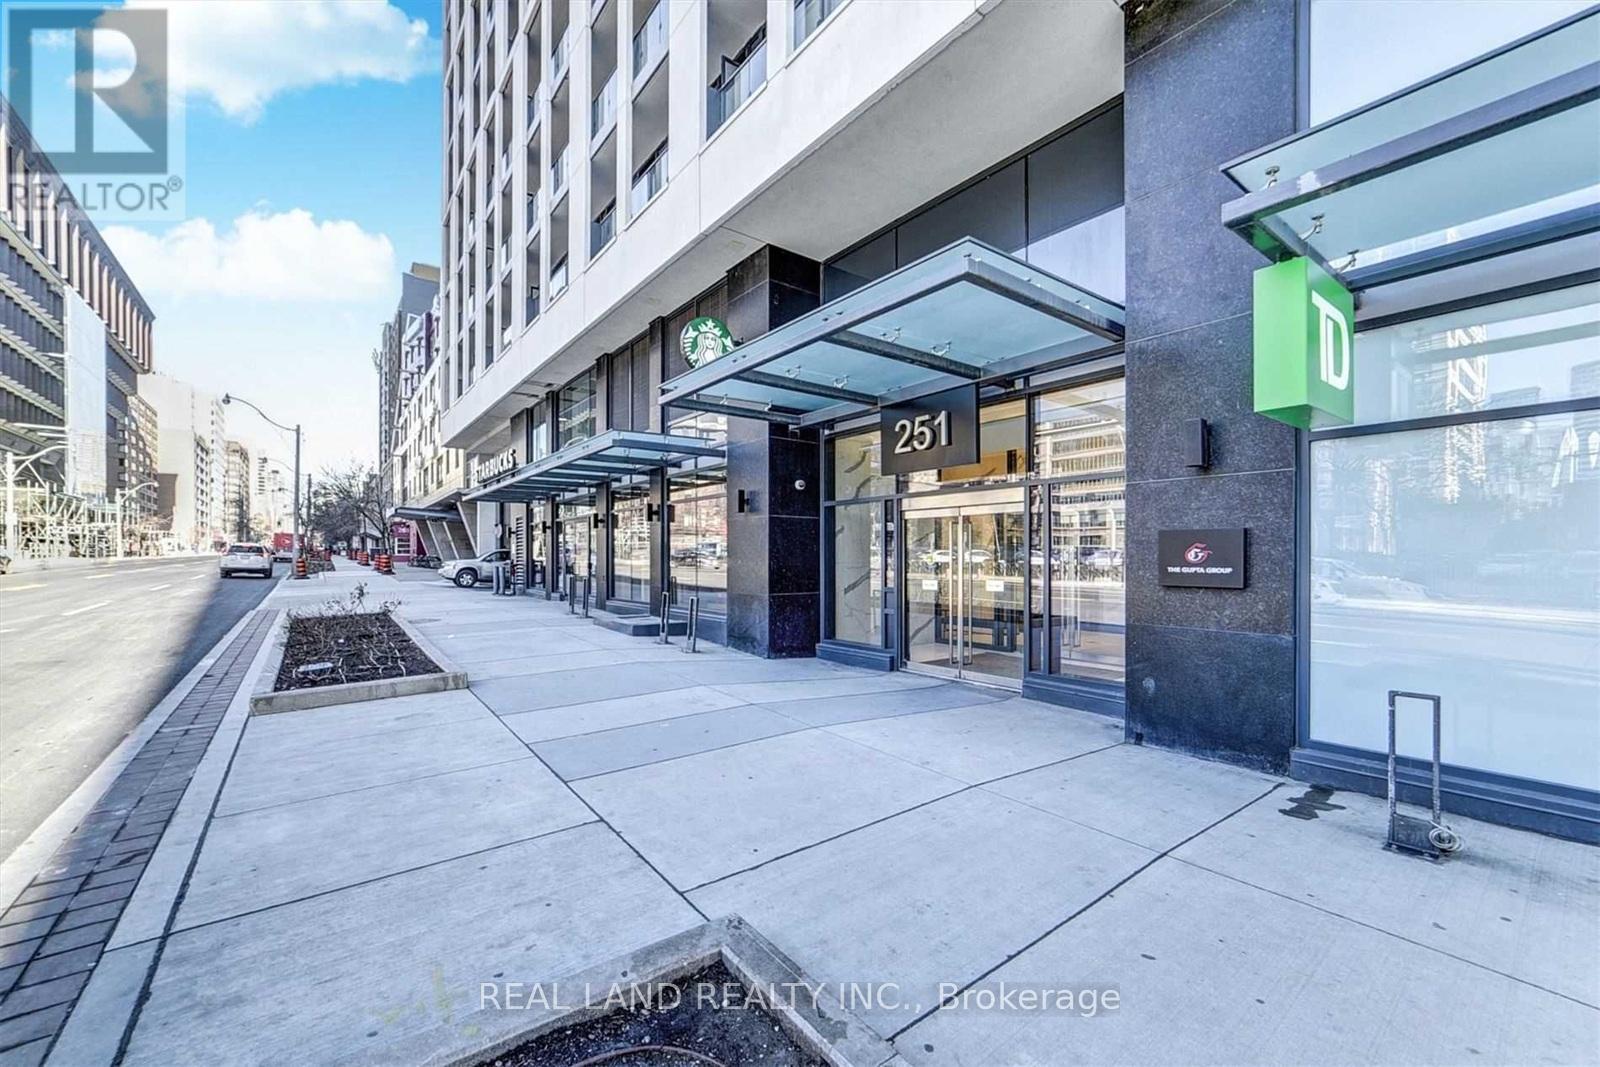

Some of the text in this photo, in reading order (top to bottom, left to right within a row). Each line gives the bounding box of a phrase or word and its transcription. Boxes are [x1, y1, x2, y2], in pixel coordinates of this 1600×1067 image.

[1311, 289, 1350, 391] TD
[894, 410, 949, 455] 251
[1167, 566, 1233, 574] THE GUPTA GROUP
